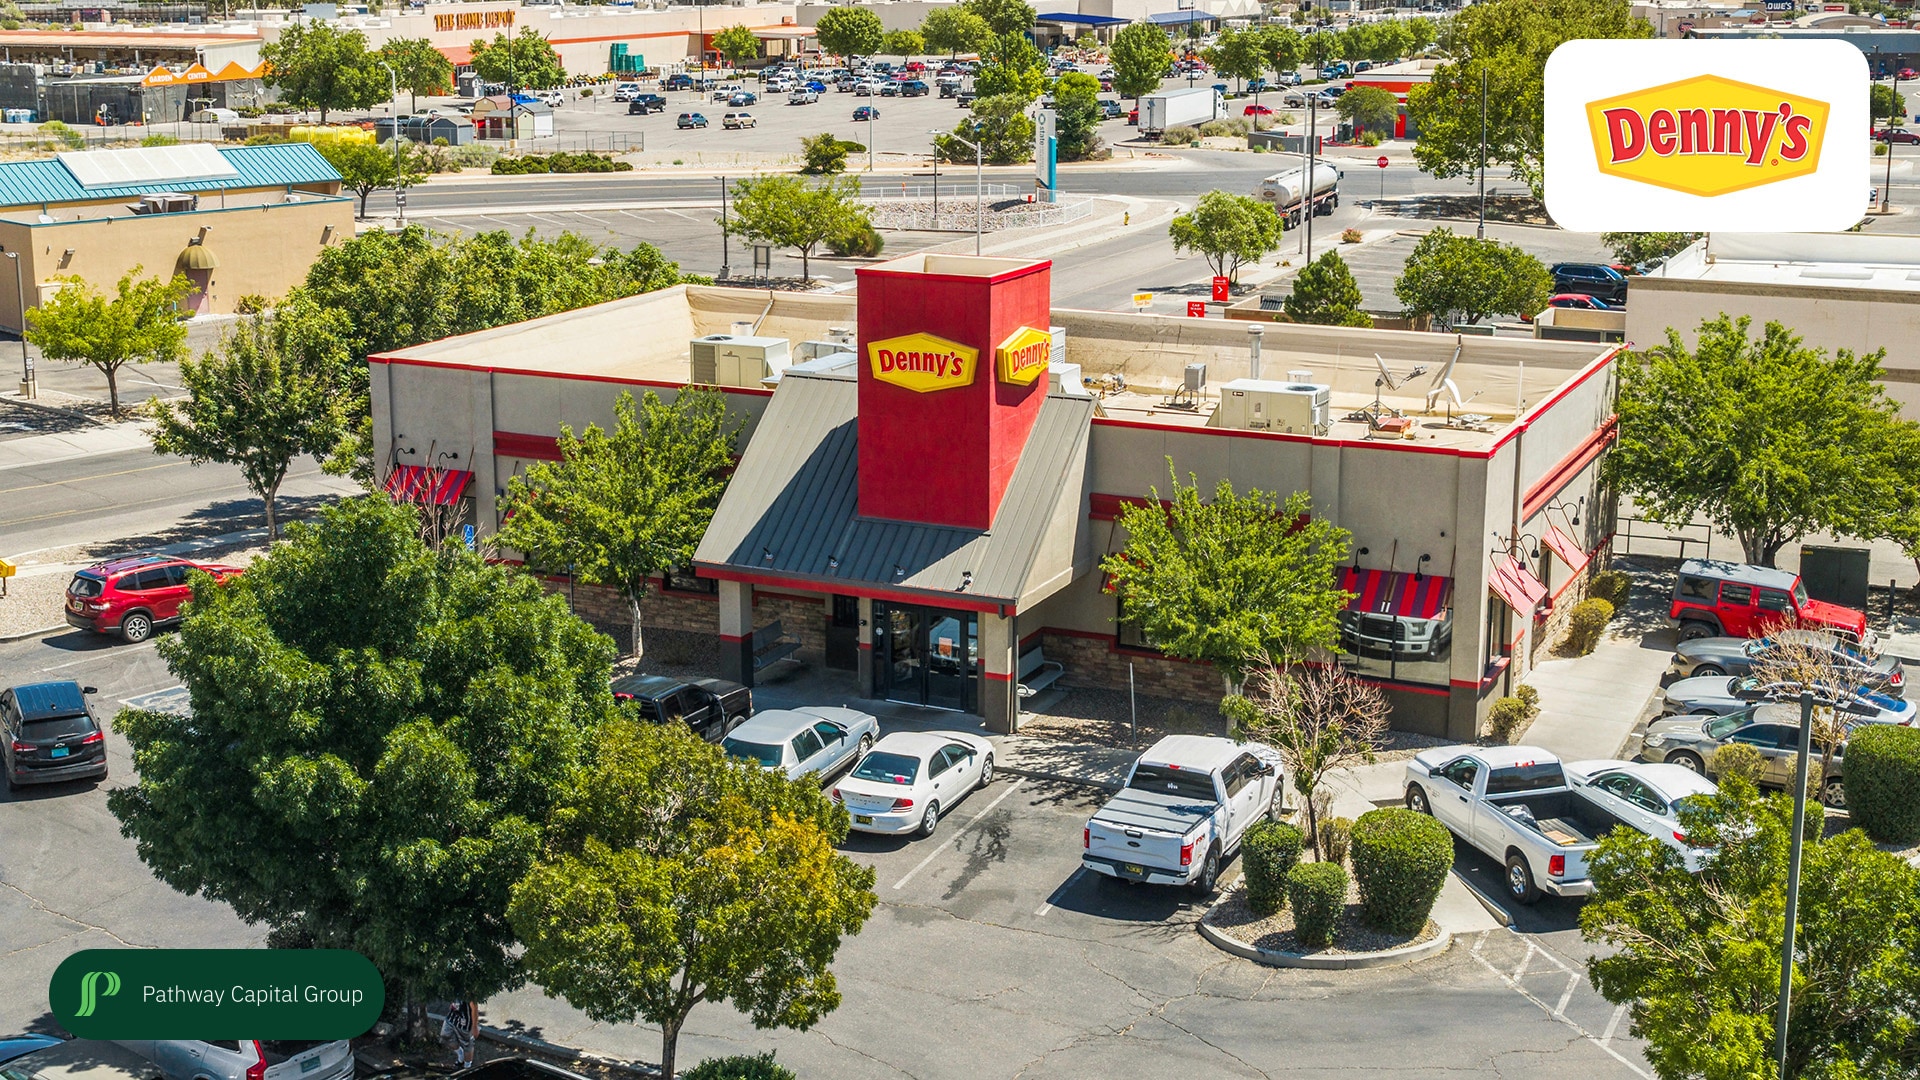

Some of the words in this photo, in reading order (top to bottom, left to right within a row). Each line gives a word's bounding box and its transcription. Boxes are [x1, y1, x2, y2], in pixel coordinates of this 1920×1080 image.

[1765, 2, 1792, 10] OWE'S
[434, 13, 455, 29] THE
[456, 12, 484, 28] HOME
[485, 10, 516, 27] DEPOT
[149, 74, 173, 83] GARDEN
[187, 72, 208, 80] CENTER
[877, 348, 965, 379] Denny's
[1011, 337, 1050, 376] Denny's
